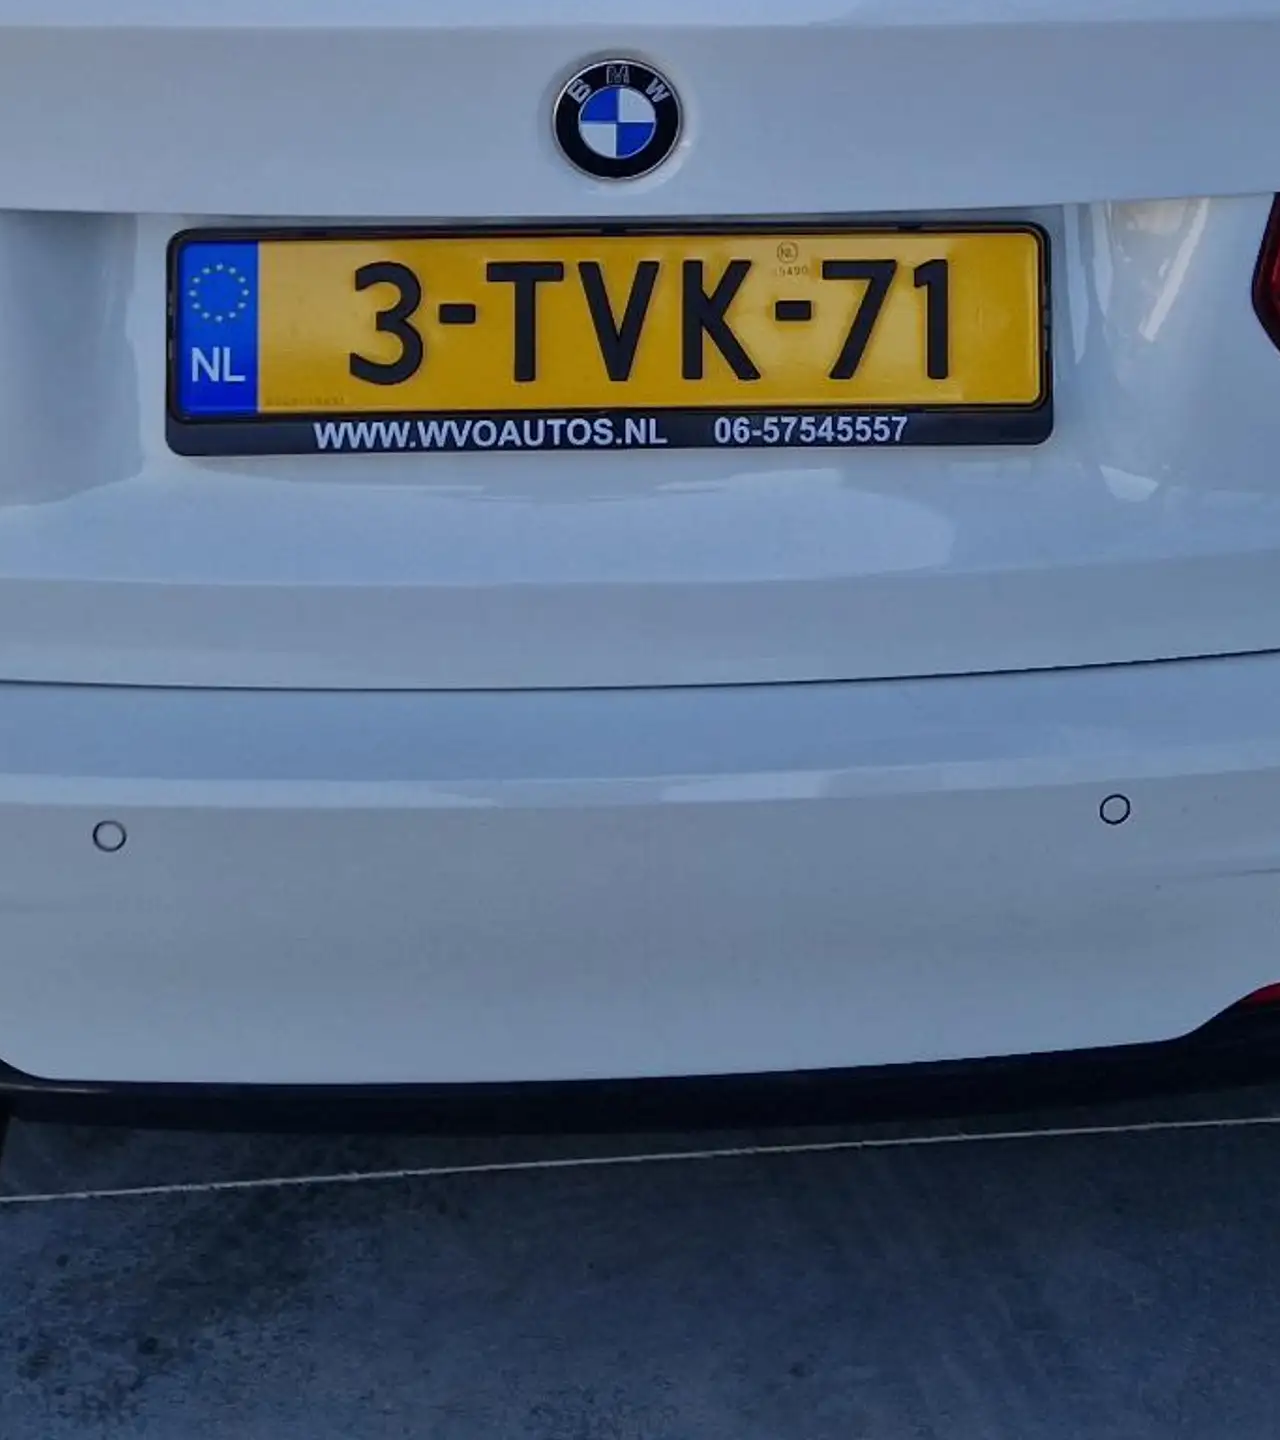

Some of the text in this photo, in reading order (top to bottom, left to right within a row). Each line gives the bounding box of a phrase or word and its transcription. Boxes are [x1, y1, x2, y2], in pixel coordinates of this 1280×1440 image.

[567, 65, 671, 104] BMW
[349, 260, 949, 384] 3-TVK-71
[191, 346, 246, 382] NL
[313, 416, 908, 450] WWW.WVOAUTOS.NL 06-57545557
